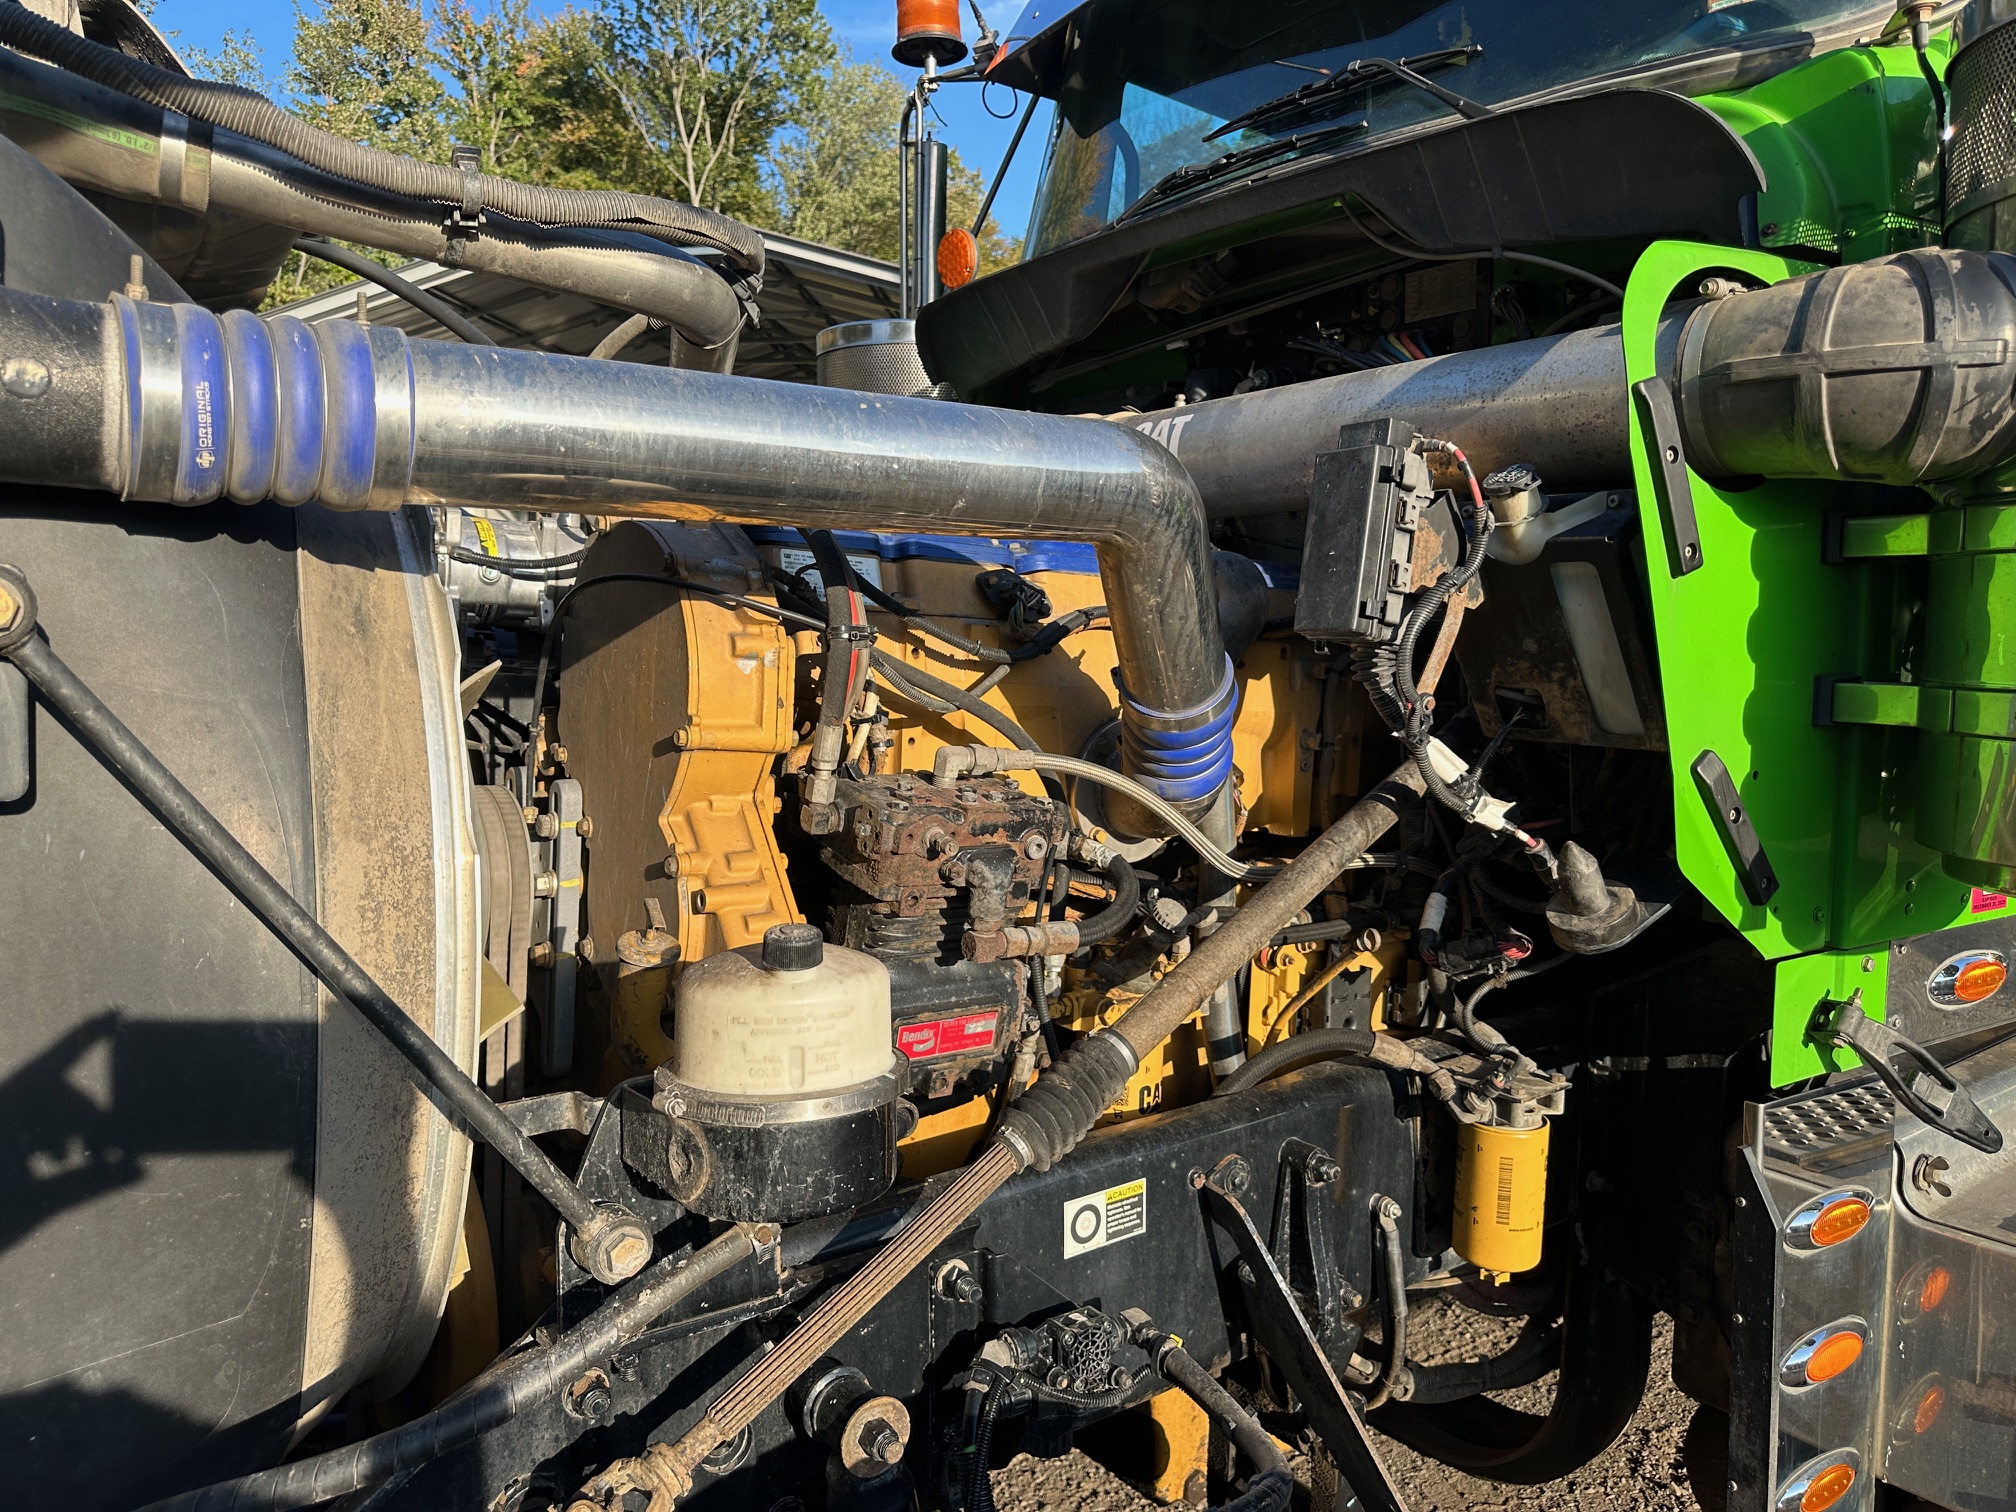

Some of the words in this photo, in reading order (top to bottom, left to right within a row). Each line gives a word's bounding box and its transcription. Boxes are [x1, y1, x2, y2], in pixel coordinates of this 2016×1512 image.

[196, 381, 207, 447] ORIGINAL
[902, 1028, 935, 1044] Bendix
[815, 1051, 839, 1064] HOT
[750, 1068, 781, 1079] COLD
[1113, 1184, 1143, 1198] CAUTION
